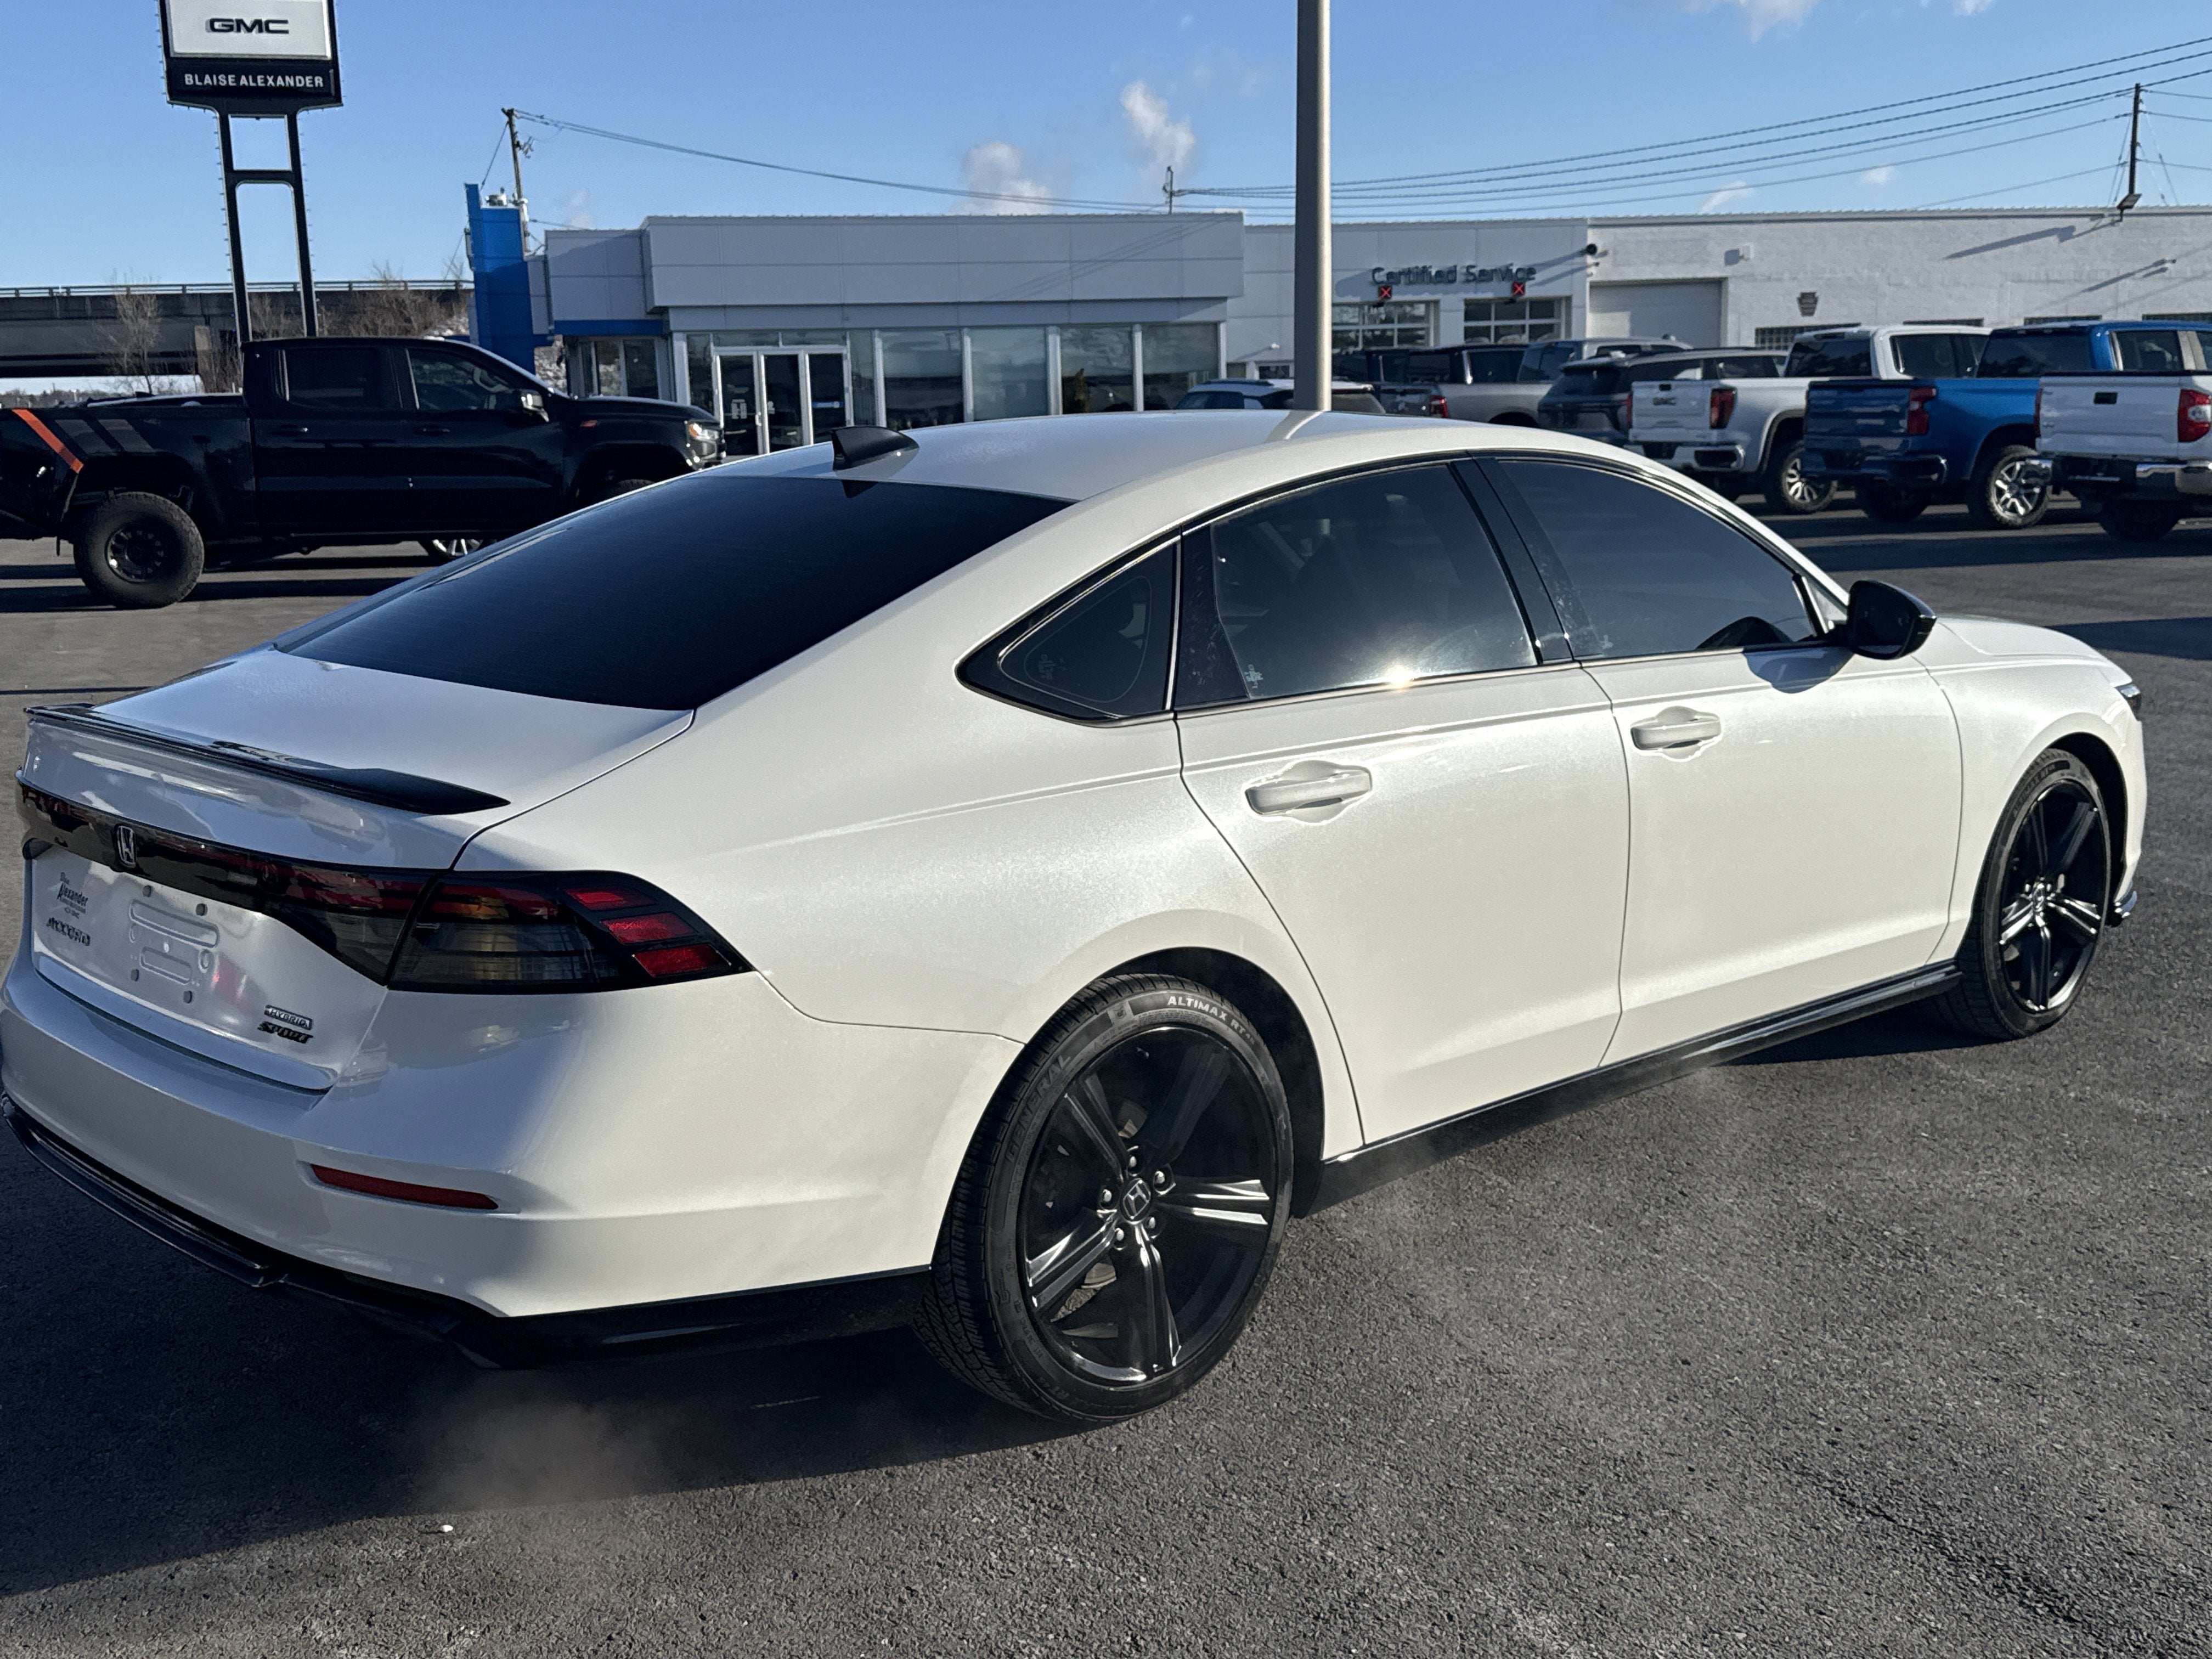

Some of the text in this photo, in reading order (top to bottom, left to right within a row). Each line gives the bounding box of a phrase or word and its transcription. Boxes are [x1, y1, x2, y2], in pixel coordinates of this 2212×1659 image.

[206, 18, 290, 35] GMC
[184, 73, 324, 88] BLAISE ALEXANDER
[1372, 263, 1536, 284] Certified Service
[269, 1008, 309, 1028] HYBRID
[1167, 996, 1228, 1022] ALTIMAX
